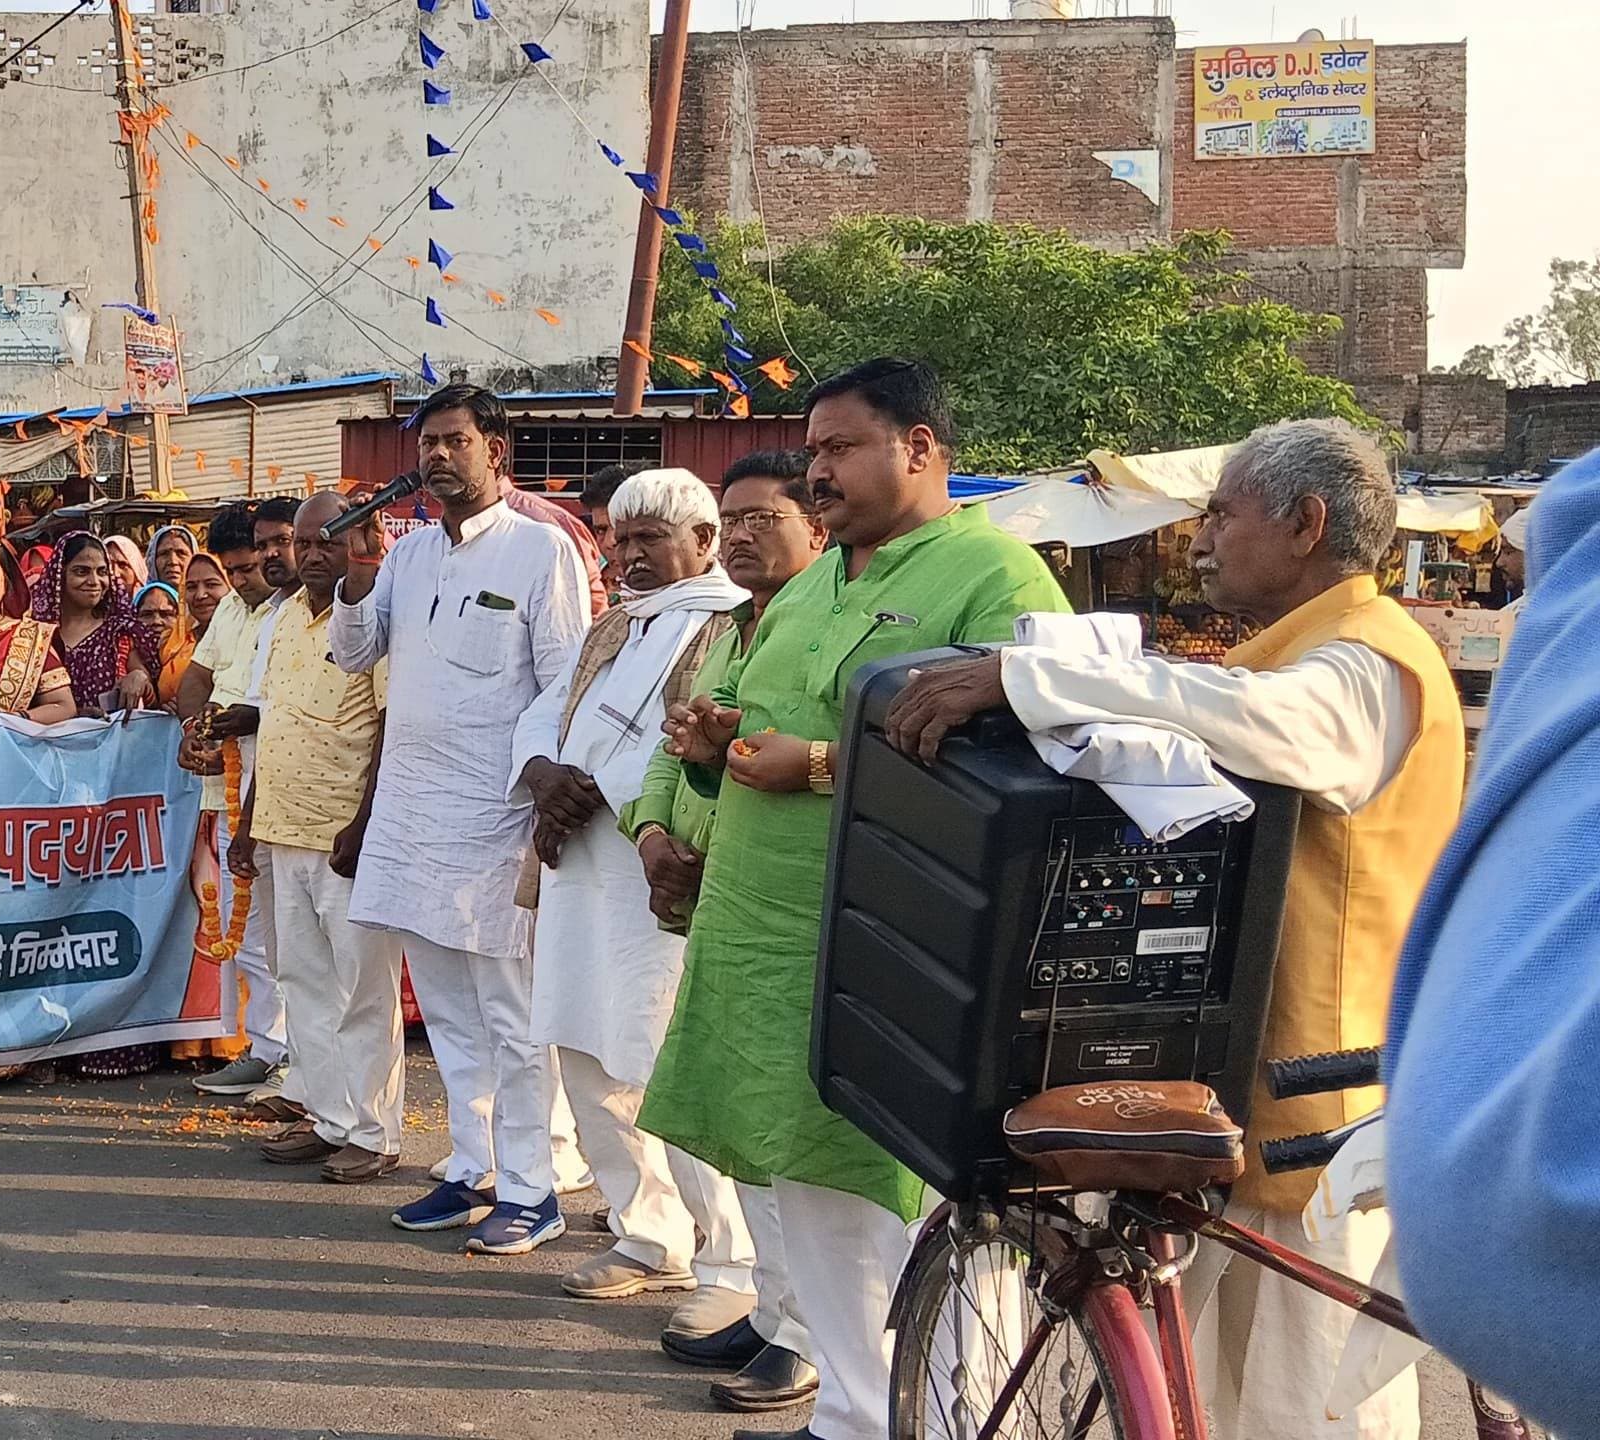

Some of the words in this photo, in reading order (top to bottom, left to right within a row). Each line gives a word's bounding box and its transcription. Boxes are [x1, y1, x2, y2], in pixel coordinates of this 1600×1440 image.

[1200, 47, 1279, 93] सुनिल
[1285, 53, 1318, 76] D.J.
[1244, 89, 1255, 101] &
[1332, 79, 1367, 96] सेन्टर
[6, 926, 119, 977] जिम्मेदार
